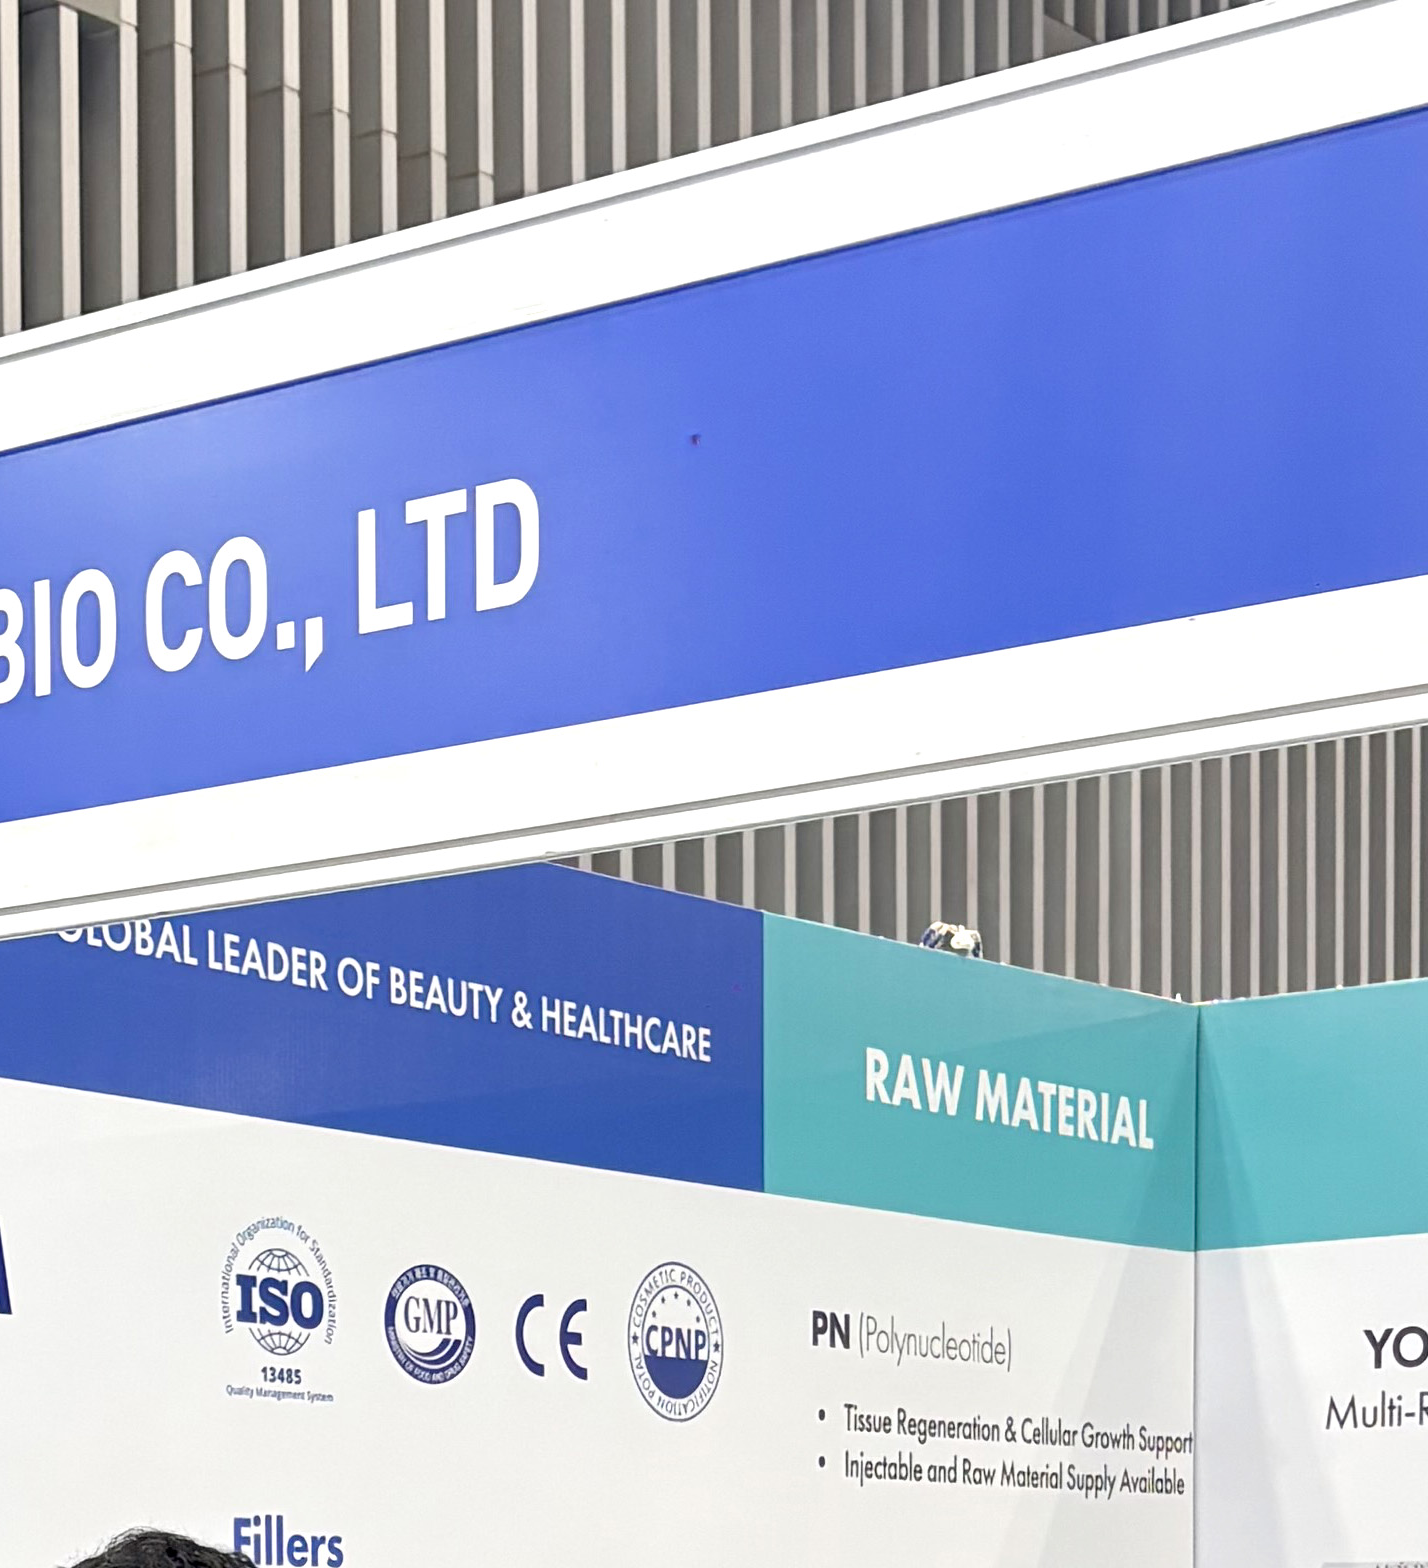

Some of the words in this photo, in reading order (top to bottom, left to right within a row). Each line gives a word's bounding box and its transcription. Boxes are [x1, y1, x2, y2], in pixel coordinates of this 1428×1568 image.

[144, 535, 324, 674] CO.,
[357, 477, 541, 636] LTD
[57, 918, 198, 967] LOBAL
[208, 929, 329, 992] LEADER
[337, 956, 380, 1001] OF
[389, 965, 503, 1025] BEAUTY
[511, 989, 533, 1030] &
[540, 995, 712, 1063] HEALTHCARE
[865, 1046, 965, 1116] RAW
[975, 1068, 1154, 1150] MATERIAL
[236, 1273, 324, 1330] ISO
[404, 1296, 458, 1335] GMP
[632, 1268, 677, 1329] COSMETIC
[679, 1271, 720, 1336] PRODUCT
[515, 1293, 588, 1382] CE
[645, 1324, 707, 1361] CPNP
[811, 1310, 851, 1350] PN
[858, 1311, 1014, 1373] (Polynucleotide)
[226, 1384, 254, 1400] Quality
[261, 1366, 302, 1385] 13485
[844, 1403, 892, 1434] Tissue
[897, 1408, 1000, 1444] Regeneration
[1004, 1416, 1018, 1443] &
[1021, 1416, 1079, 1447] Cellular
[1081, 1422, 1135, 1452] Growth
[1139, 1426, 1193, 1460] Support
[844, 1450, 924, 1487] Injectable
[927, 1455, 958, 1485] and
[962, 1457, 997, 1487] Raw
[1001, 1460, 1064, 1491] Material
[1066, 1464, 1117, 1500] Supply
[1120, 1467, 1186, 1496] Available
[233, 1514, 345, 1568] Fillers
